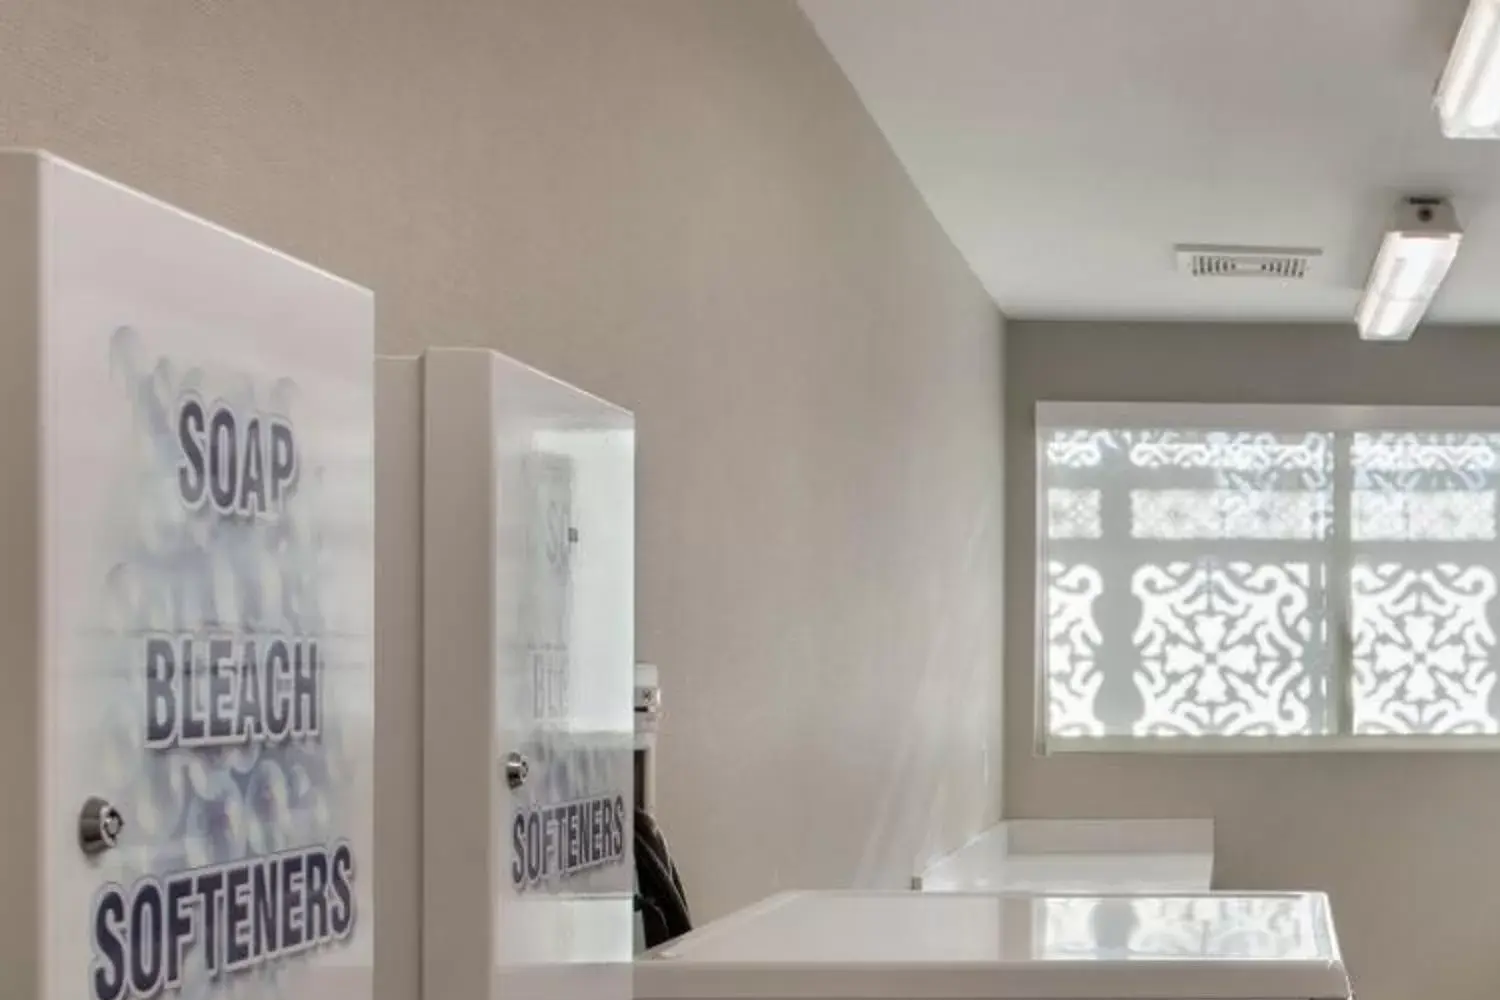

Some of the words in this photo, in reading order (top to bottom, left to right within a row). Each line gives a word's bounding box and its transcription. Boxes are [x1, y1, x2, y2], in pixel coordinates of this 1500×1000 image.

[177, 398, 298, 518] SOAP
[144, 635, 324, 748] BLEACH
[511, 793, 627, 889] SOFTENERS
